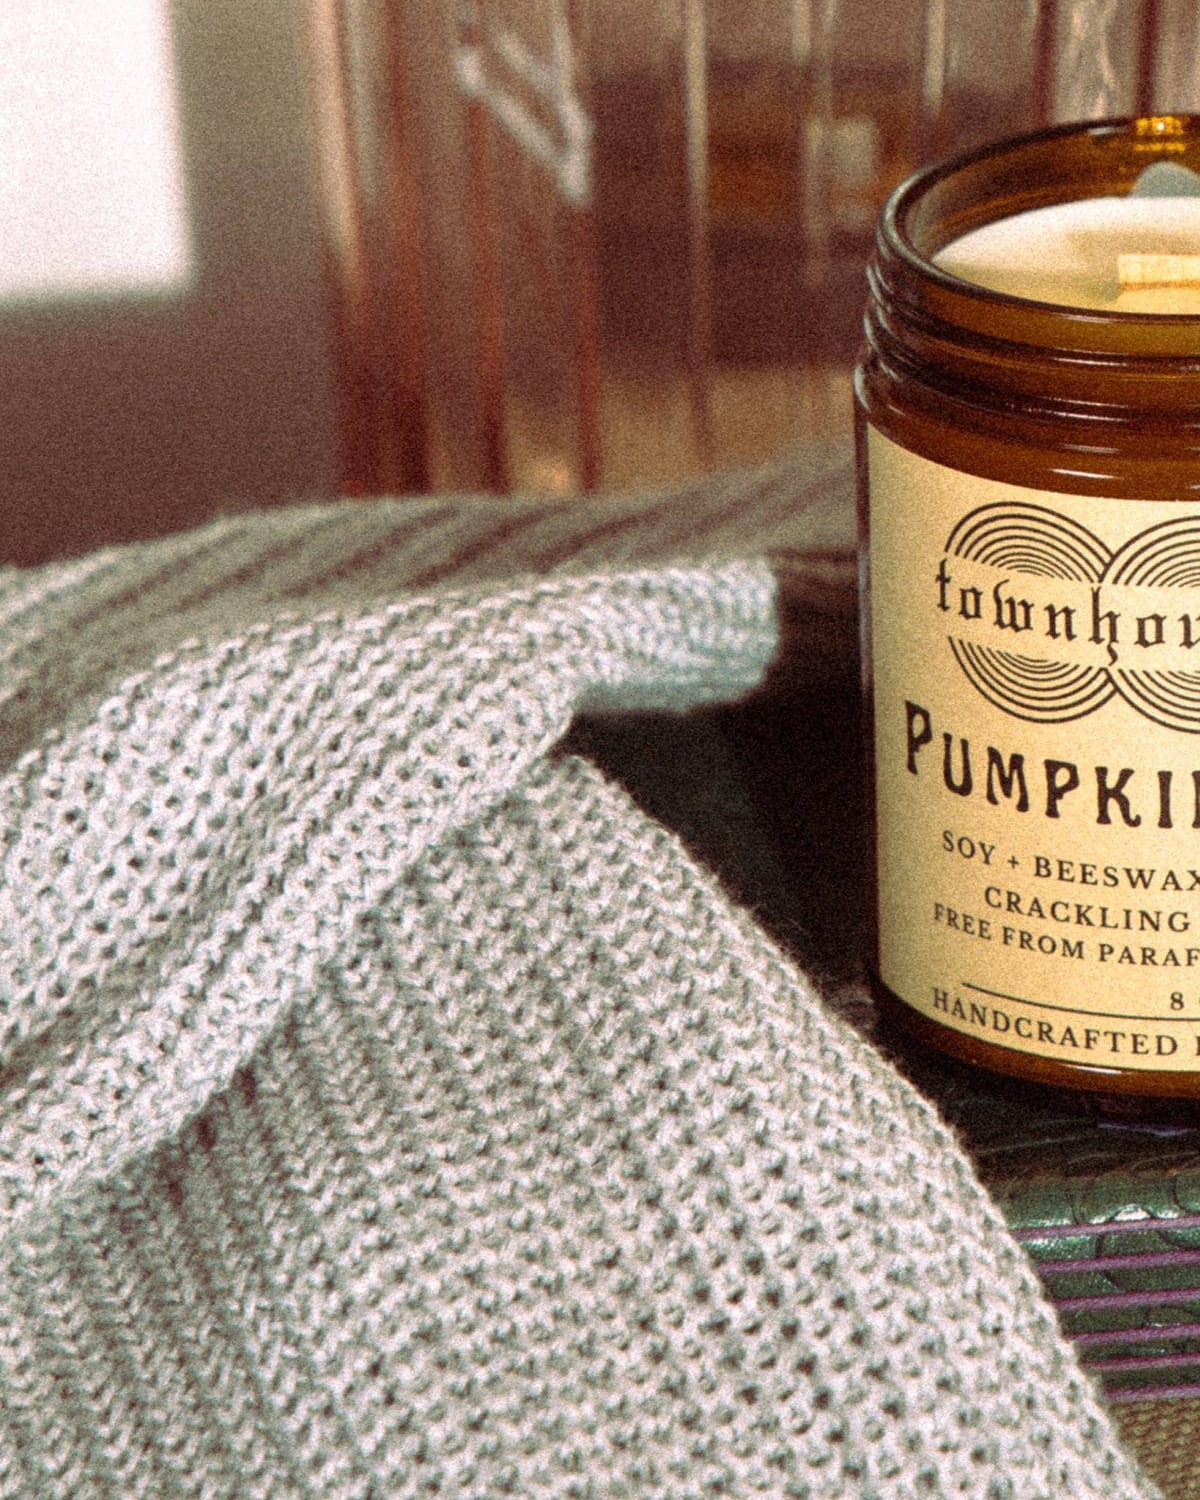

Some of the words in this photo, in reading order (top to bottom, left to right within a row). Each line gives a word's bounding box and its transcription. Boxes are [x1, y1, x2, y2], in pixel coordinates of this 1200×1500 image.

[942, 830, 995, 865] SOY
[934, 902, 992, 941] FREE
[1002, 926, 1084, 959] FROM
[984, 885, 1191, 933] CRACKLING
[932, 987, 1178, 1056] HANDCRAFTED
[1170, 991, 1185, 1011] 8
